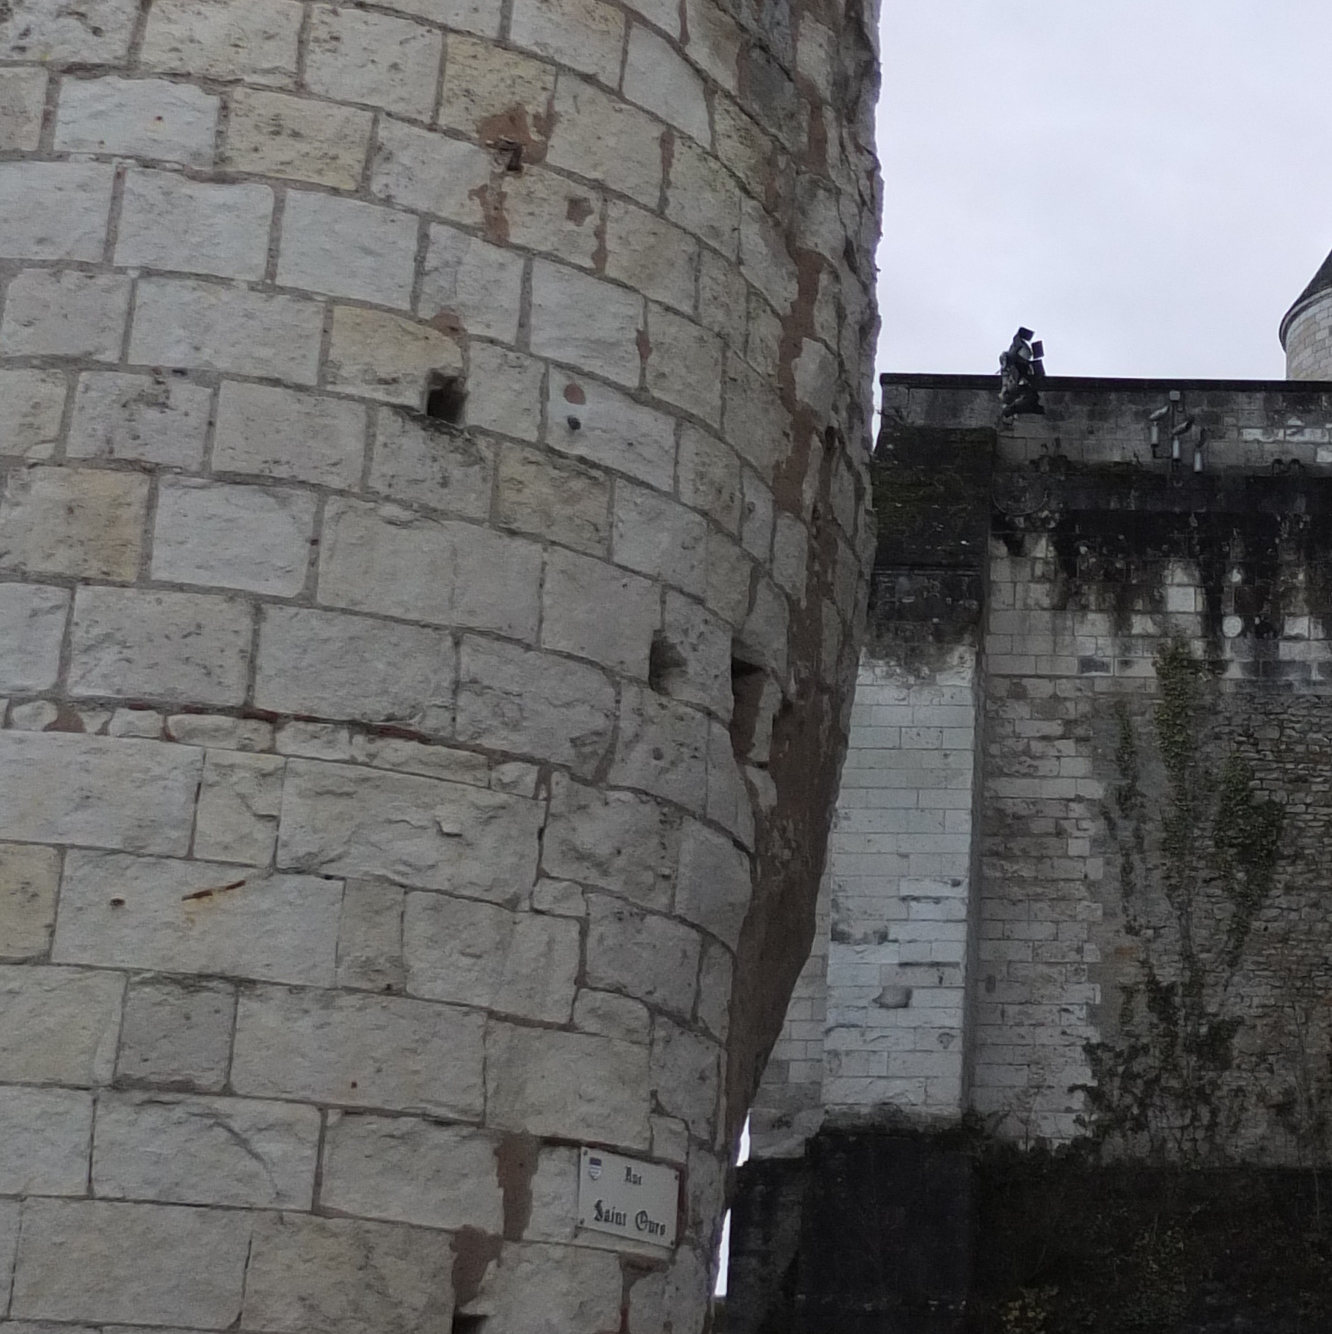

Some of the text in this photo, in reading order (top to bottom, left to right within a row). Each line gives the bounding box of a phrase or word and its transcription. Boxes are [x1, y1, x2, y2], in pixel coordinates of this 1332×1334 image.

[625, 1166, 642, 1185] Rue
[594, 1199, 666, 1236] Saint Ours
